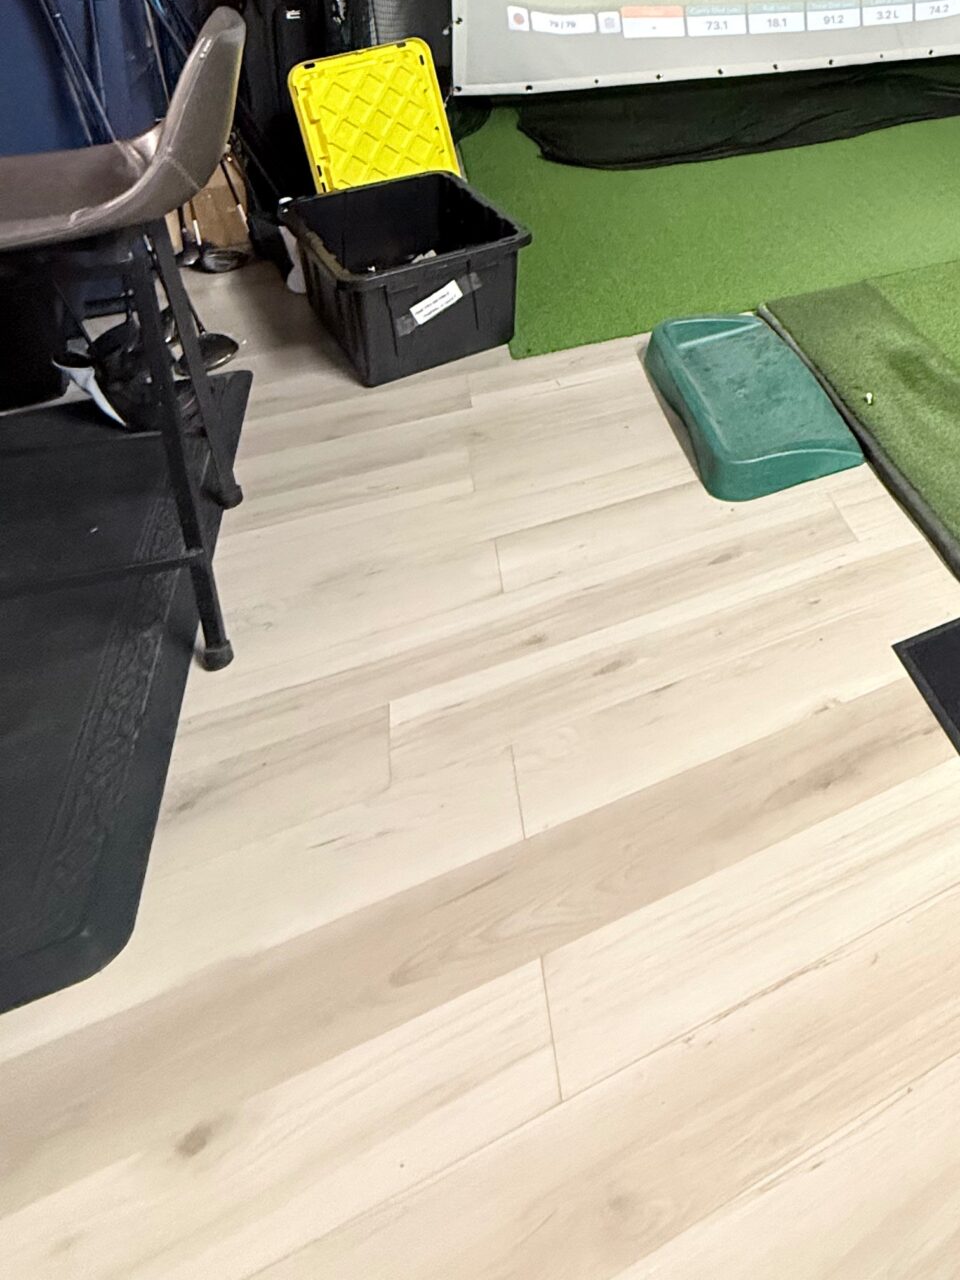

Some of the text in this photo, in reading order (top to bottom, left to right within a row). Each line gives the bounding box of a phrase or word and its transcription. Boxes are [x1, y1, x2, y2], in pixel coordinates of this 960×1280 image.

[929, 4, 950, 15] 74.2
[767, 18, 787, 28] 18.1
[823, 14, 844, 25] 91.2
[706, 20, 728, 31] 73.1
